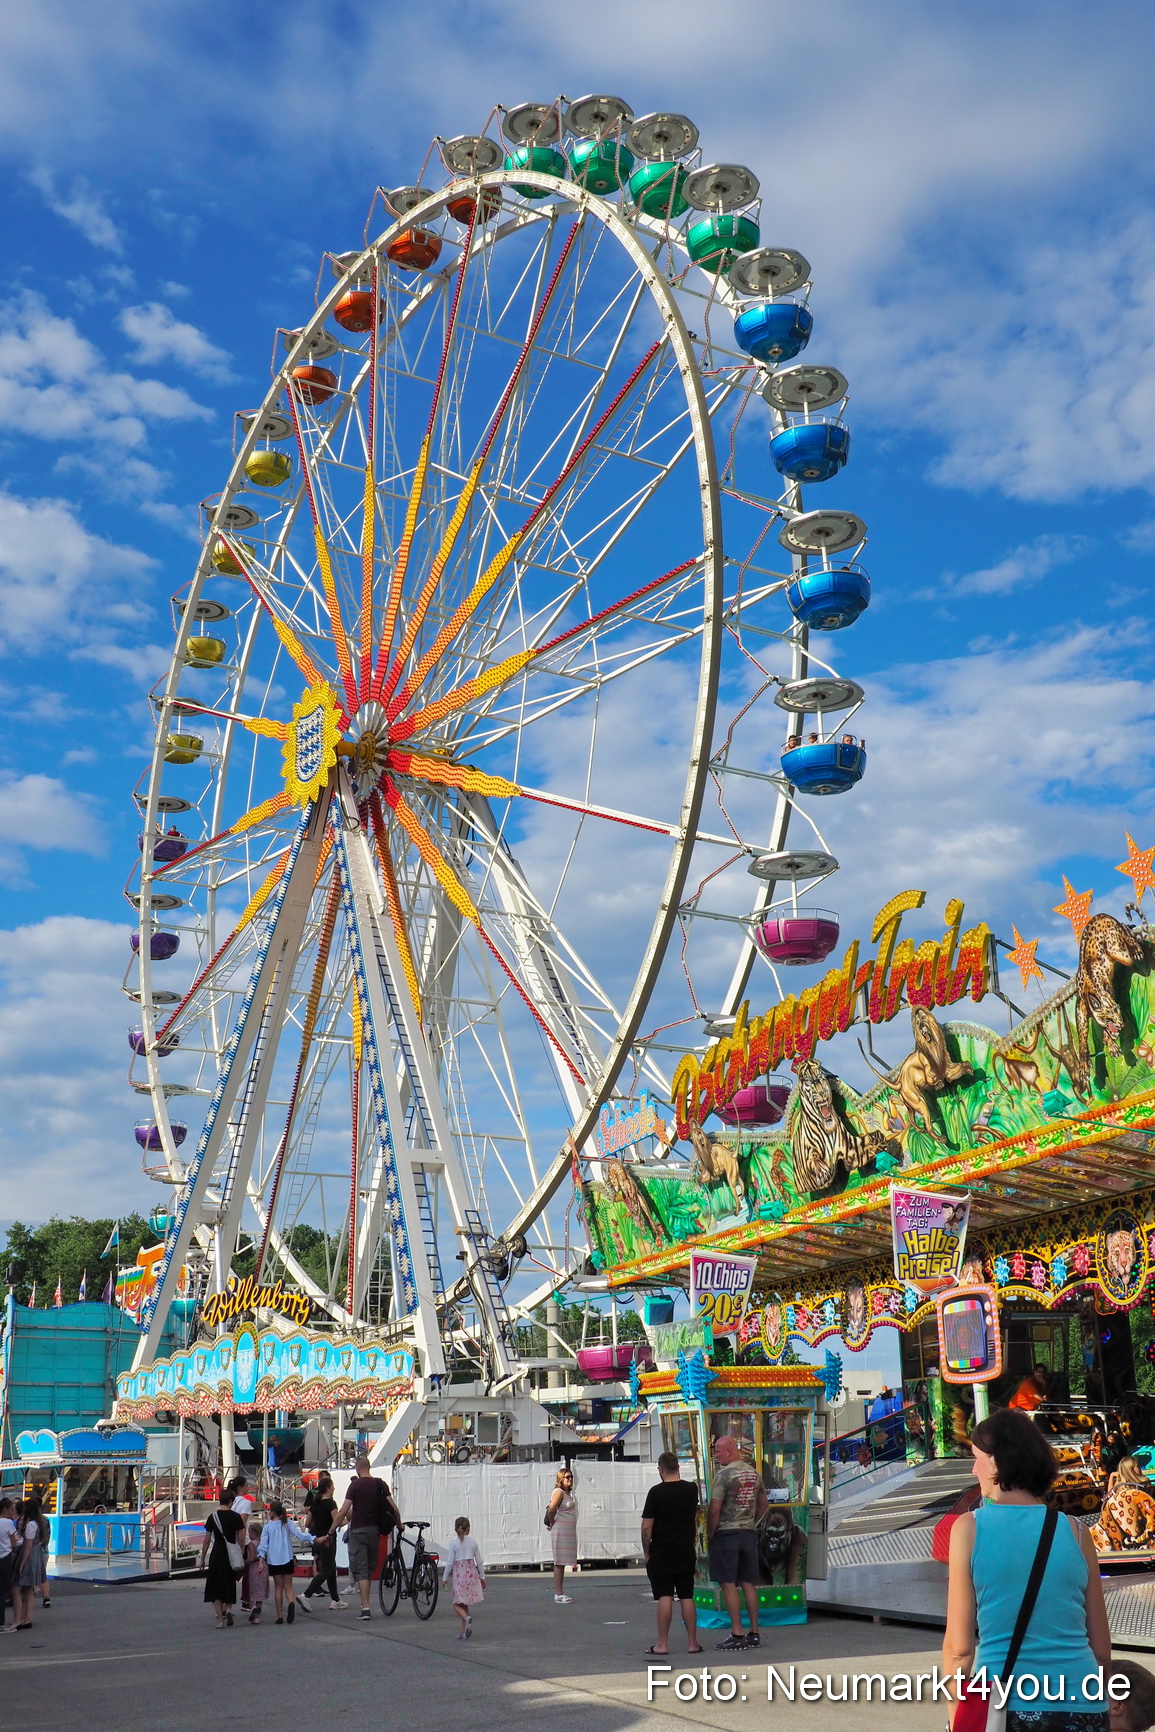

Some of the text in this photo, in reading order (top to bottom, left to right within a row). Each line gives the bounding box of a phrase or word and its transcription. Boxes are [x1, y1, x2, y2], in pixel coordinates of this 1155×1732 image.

[895, 1206, 942, 1218] FAMILIEN-
[909, 1195, 930, 1207] ZUM
[906, 1218, 928, 1228] TAG:
[902, 1228, 958, 1256] Halbe
[696, 1261, 749, 1296] 10 Chips
[898, 1252, 959, 1279] Preise!
[202, 1273, 312, 1327] Willenborg
